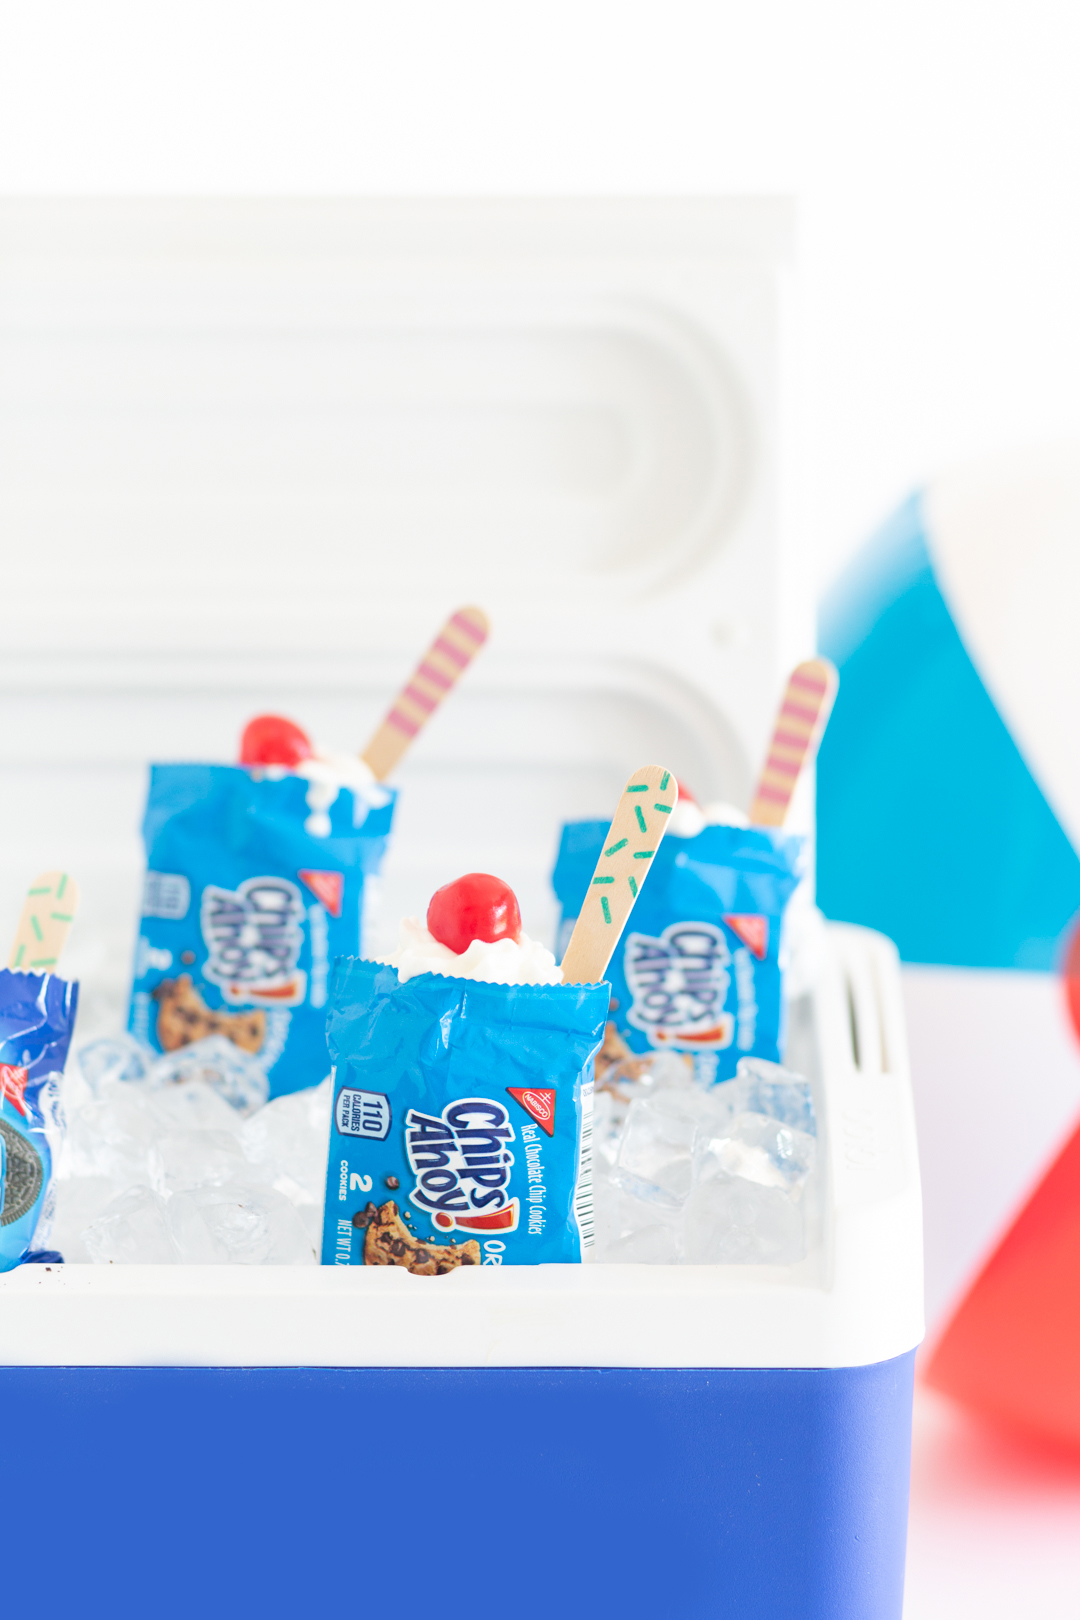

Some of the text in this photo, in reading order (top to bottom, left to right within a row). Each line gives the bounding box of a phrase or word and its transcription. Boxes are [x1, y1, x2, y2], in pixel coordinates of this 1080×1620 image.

[342, 1094, 351, 1128] PER PACK
[350, 1094, 362, 1132] CALORIES
[362, 1101, 383, 1132] 110
[524, 1093, 548, 1118] NABISCO
[446, 1101, 514, 1210] Chips
[338, 1160, 348, 1201] COOKIES
[350, 1173, 373, 1192] 2
[521, 1123, 545, 1235] Real Chocolate Chip Cookies
[337, 1219, 352, 1236] NET
[336, 1238, 352, 1252] WT
